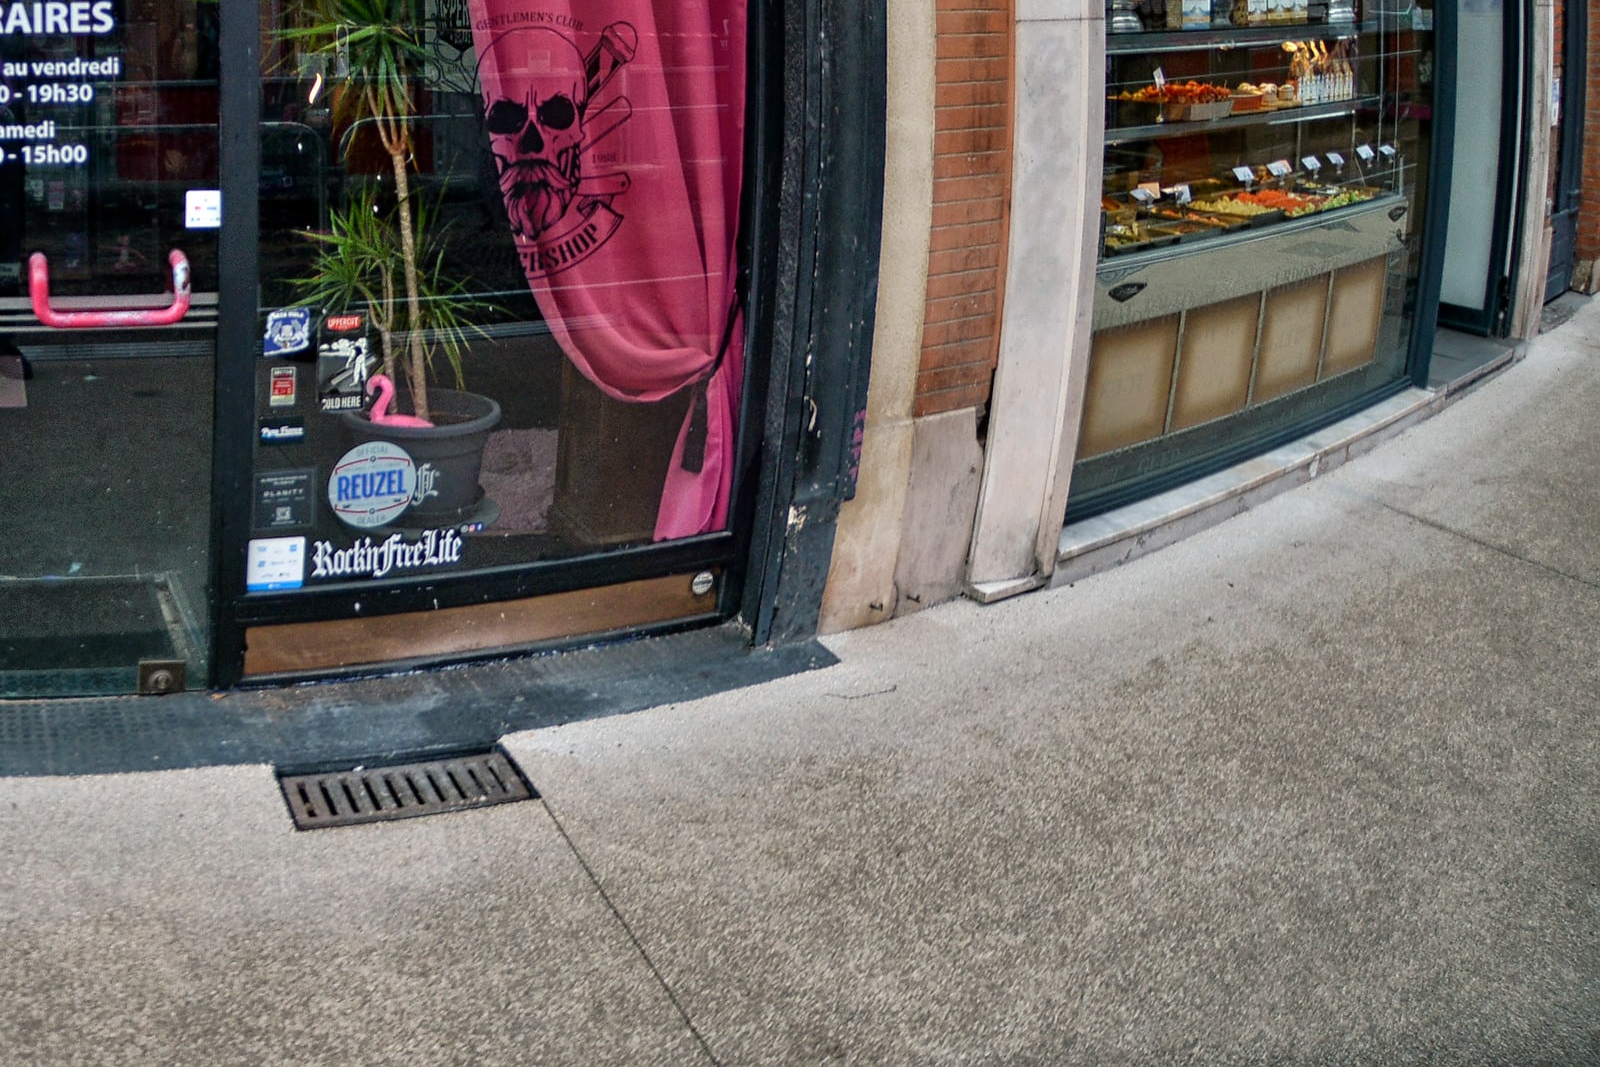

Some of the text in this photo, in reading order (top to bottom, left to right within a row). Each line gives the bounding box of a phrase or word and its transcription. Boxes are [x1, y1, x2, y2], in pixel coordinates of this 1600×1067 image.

[475, 11, 584, 32] GENTLEMEN'S CLUB
[2, 61, 29, 77] au
[31, 56, 120, 77] vendredi
[27, 83, 94, 104] 19h30
[21, 144, 88, 164] 15h00
[327, 316, 359, 328] UPPERCUT
[341, 395, 362, 408] HERE
[337, 468, 408, 502] REUZEL
